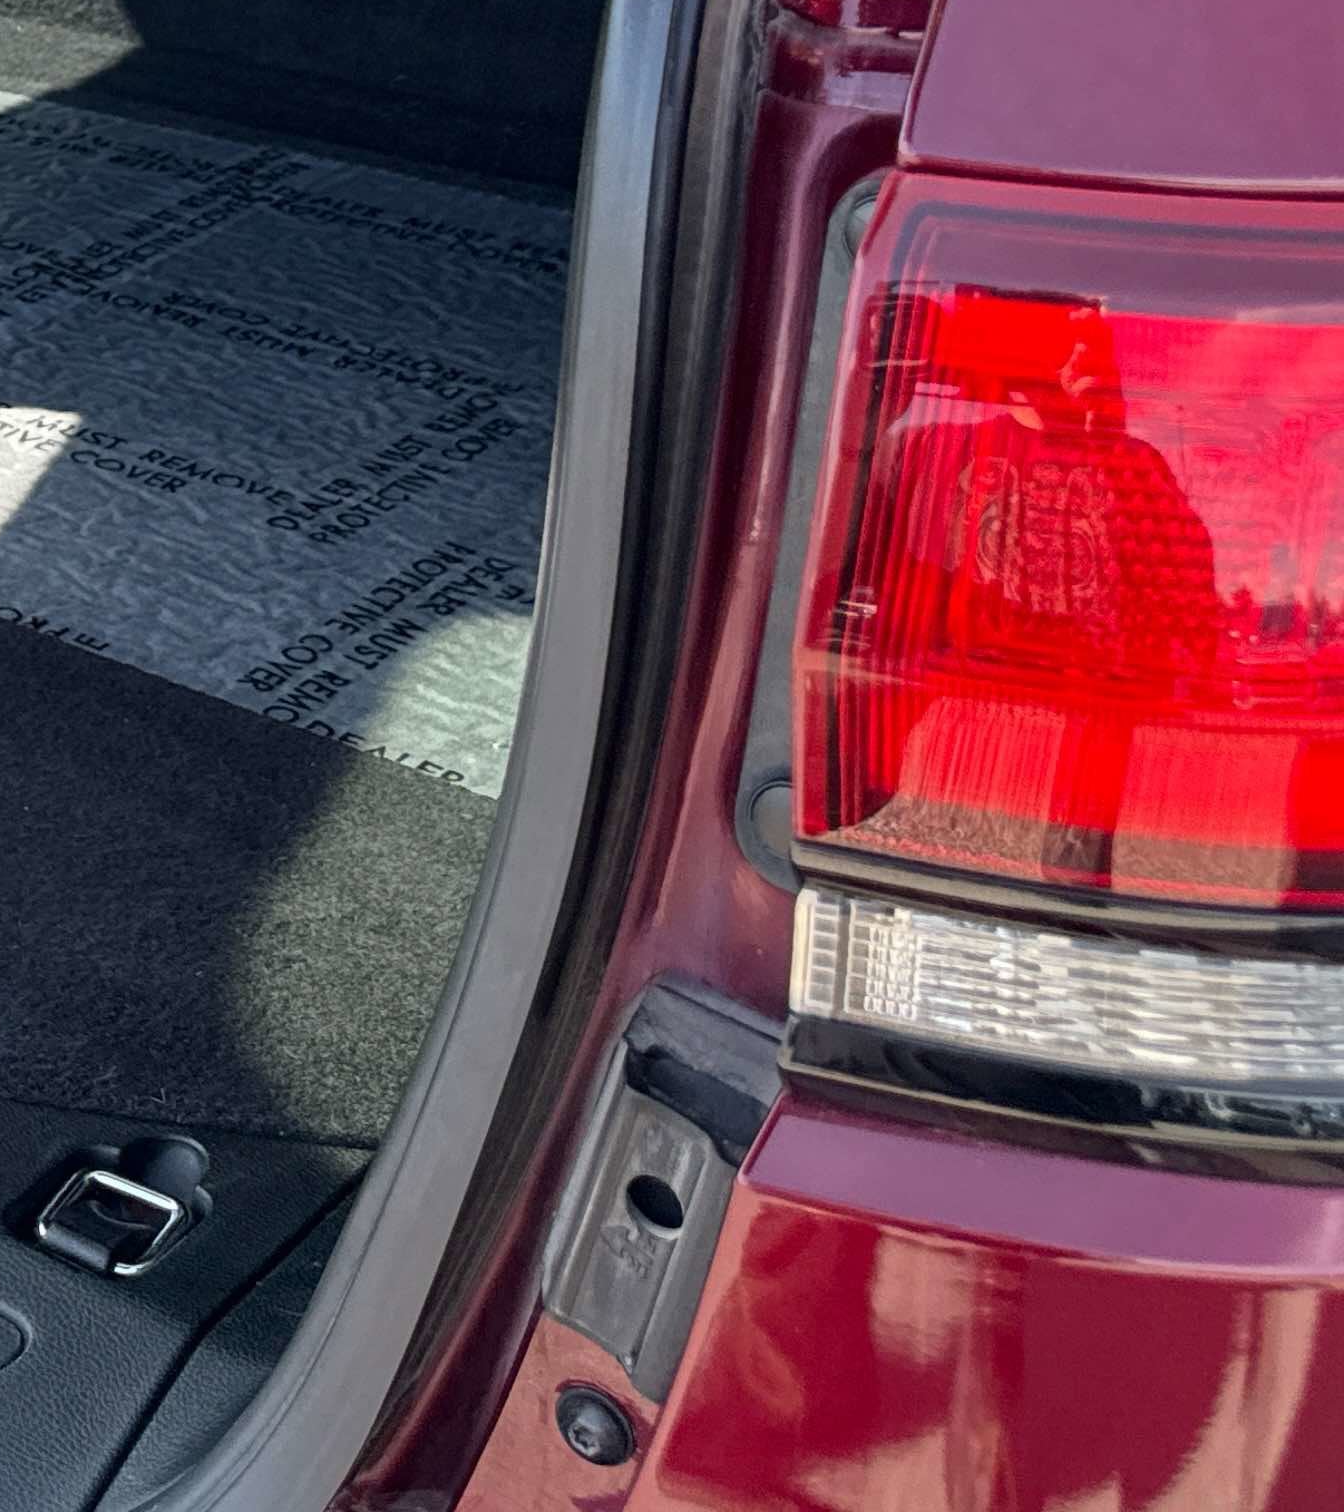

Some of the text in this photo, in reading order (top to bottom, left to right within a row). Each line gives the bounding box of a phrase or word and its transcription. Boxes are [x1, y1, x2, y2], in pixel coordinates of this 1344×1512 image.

[25, 414, 129, 451] MUST
[138, 447, 296, 505] REMOVE
[69, 449, 188, 494] COVER
[266, 477, 368, 531] DEALER
[362, 433, 433, 476] MUST
[309, 417, 524, 545] PROTECTIVE COVER
[236, 541, 477, 692] PROTECTIVE COVER
[416, 556, 518, 616] DEALER
[343, 617, 430, 671] MUST
